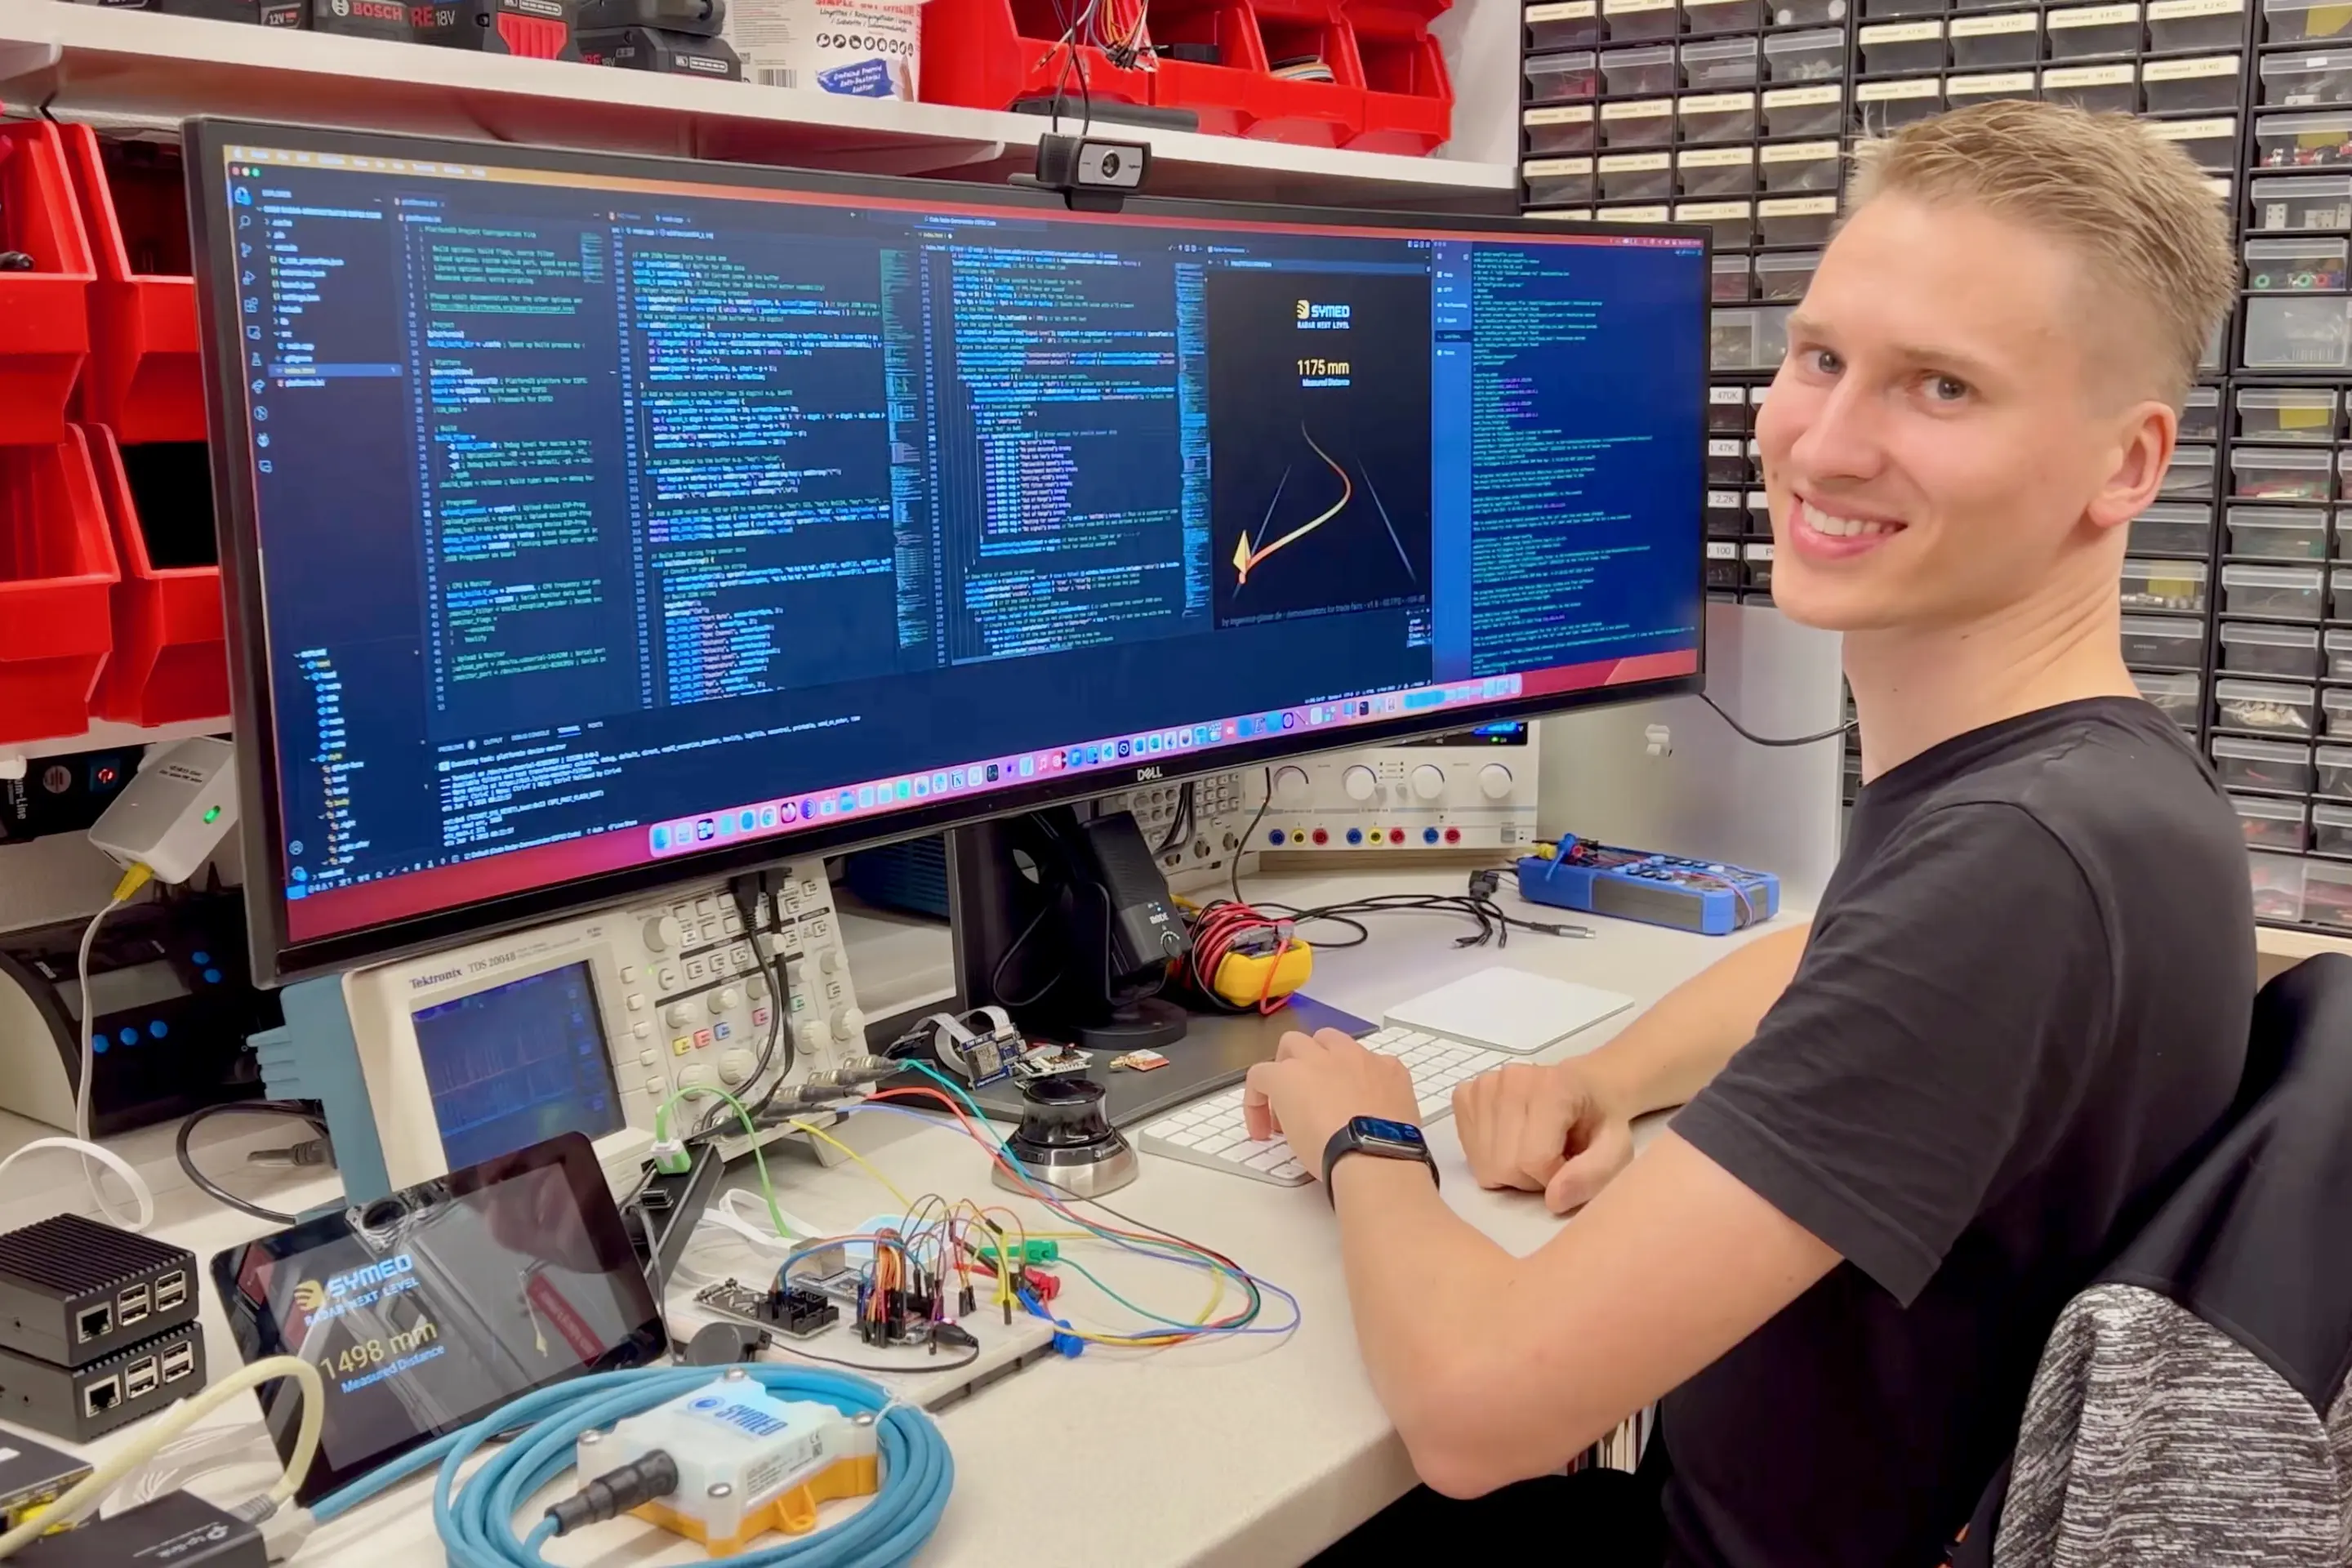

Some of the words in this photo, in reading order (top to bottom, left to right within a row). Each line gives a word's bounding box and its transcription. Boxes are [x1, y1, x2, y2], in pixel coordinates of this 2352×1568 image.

[353, 2, 403, 20] BOSCH
[435, 10, 456, 25] 18V
[1297, 359, 1325, 376] 1175
[1327, 362, 1349, 375] mm
[1718, 443, 1734, 452] 47K
[1717, 546, 1731, 555] 100
[1137, 766, 1163, 782] DELL
[409, 967, 463, 989] Tektronix
[468, 960, 487, 973] TDS
[304, 1304, 345, 1327] RADAR
[350, 1291, 378, 1310] NEXT
[383, 1277, 420, 1295] LEVEL
[320, 1339, 385, 1380] 1498
[390, 1321, 439, 1353] mm
[341, 1361, 396, 1394] Measured
[398, 1345, 445, 1370] Distance
